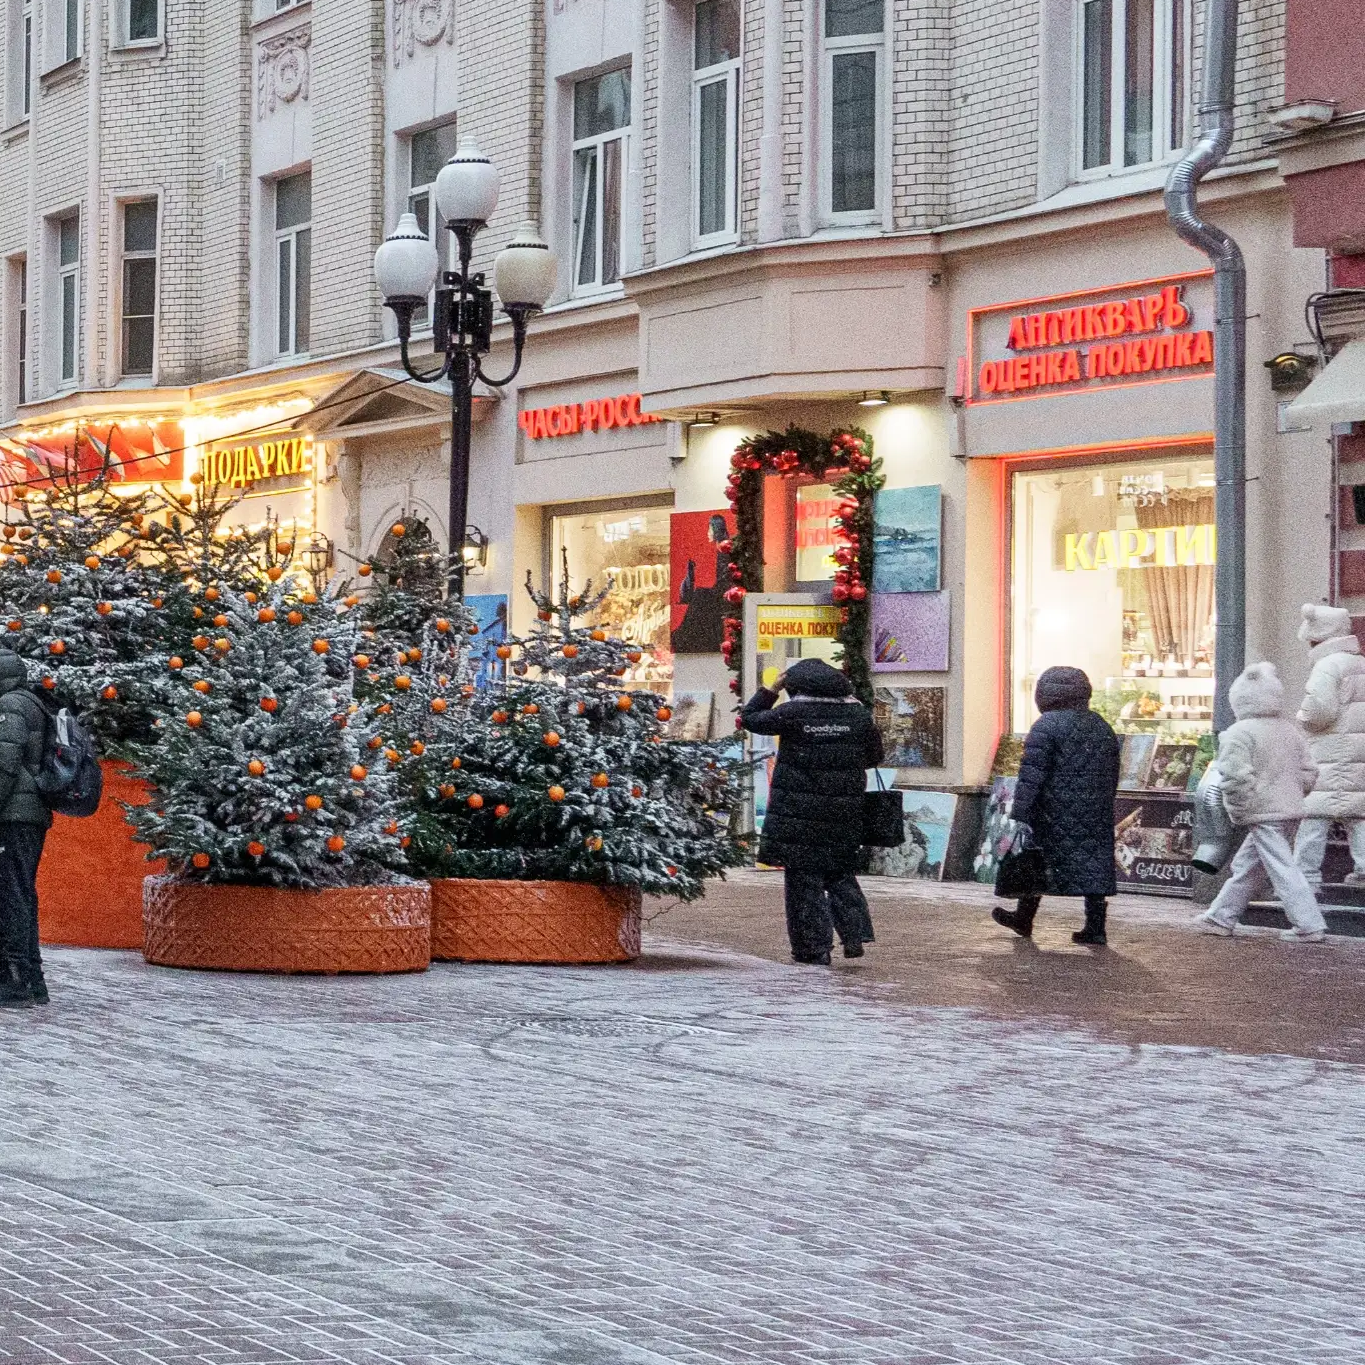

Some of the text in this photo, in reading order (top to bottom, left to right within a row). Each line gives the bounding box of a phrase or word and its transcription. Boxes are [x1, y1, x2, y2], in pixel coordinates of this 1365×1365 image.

[979, 330, 1213, 392] ОЦЕНКА ПОКУПКА
[519, 392, 663, 440] ЧАСЫ РОСС
[203, 436, 308, 489] ПОДАРКИ
[1065, 524, 1216, 571] КАРТИ
[758, 620, 804, 637] ОЦЕНКА
